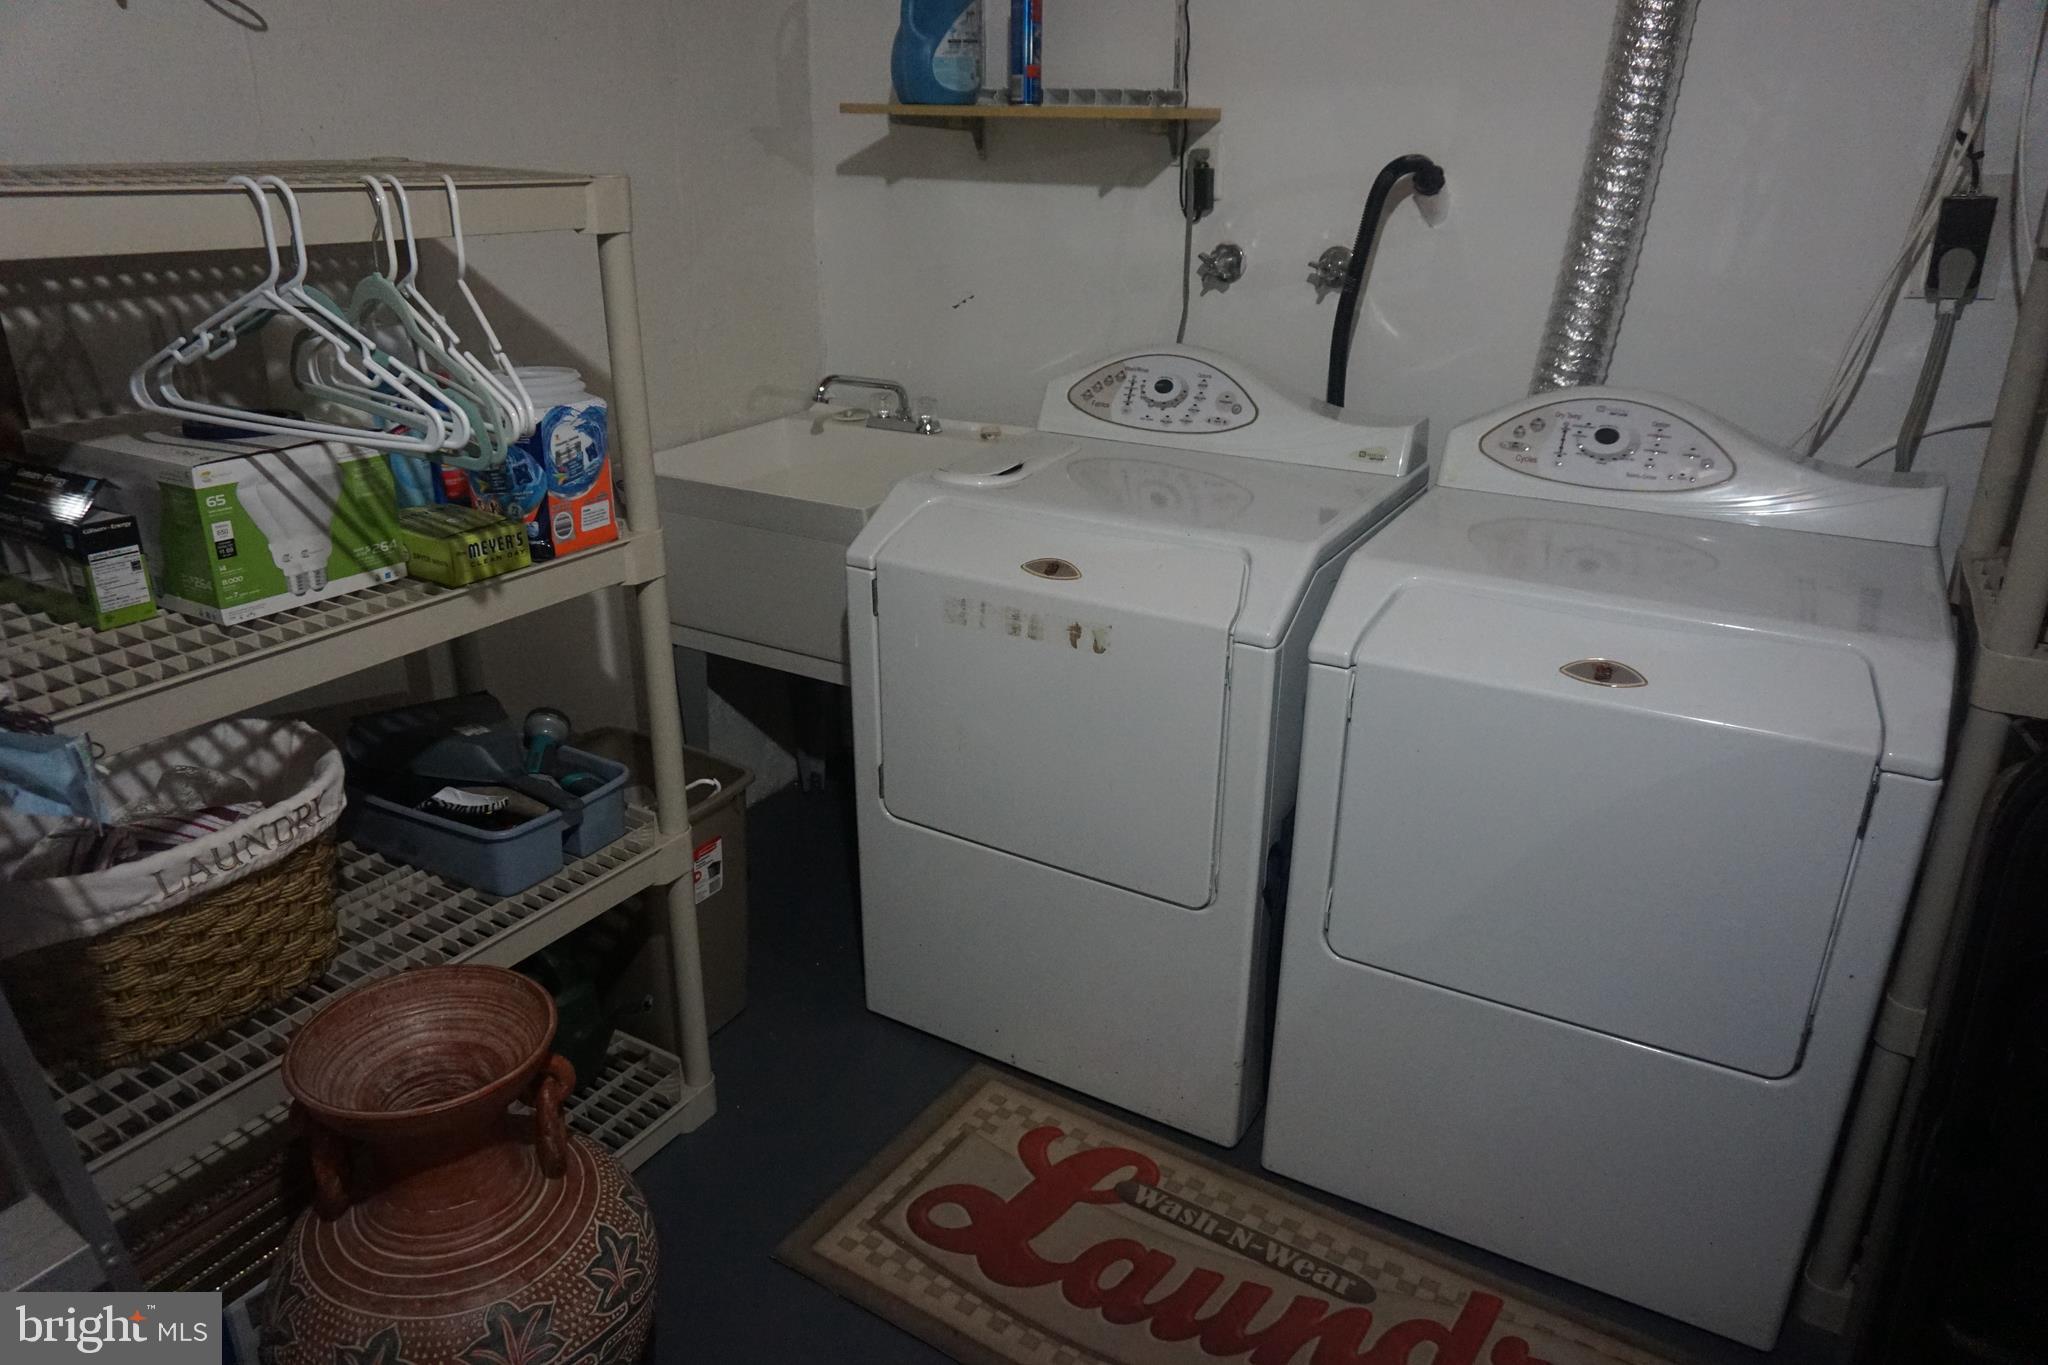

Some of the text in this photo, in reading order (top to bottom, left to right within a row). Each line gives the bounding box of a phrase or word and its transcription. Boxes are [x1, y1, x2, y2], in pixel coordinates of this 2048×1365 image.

[205, 494, 226, 508] 65
[468, 532, 524, 559] MEYER'S
[152, 789, 328, 899] LAUNDRY
[1130, 1184, 1359, 1295] Wash-N-Wear
